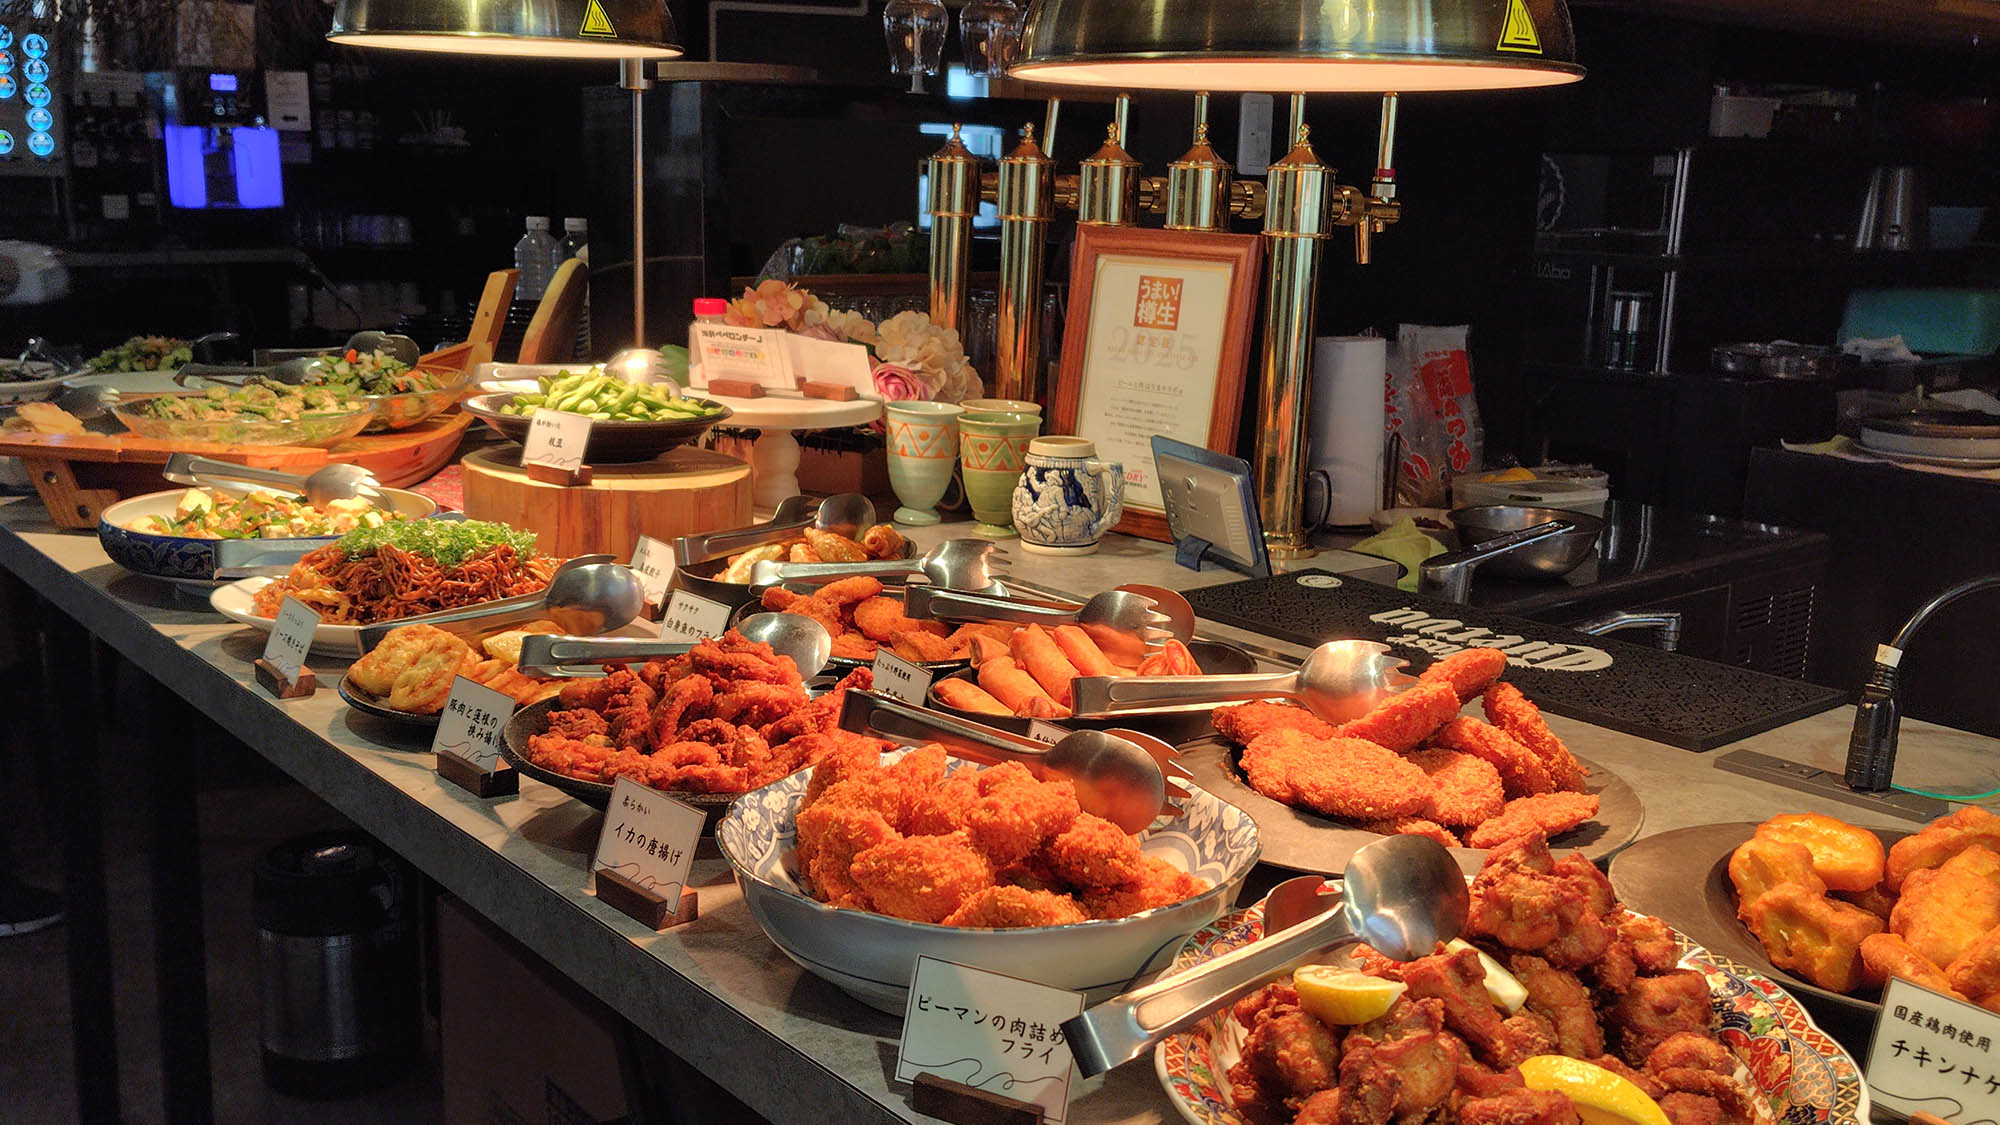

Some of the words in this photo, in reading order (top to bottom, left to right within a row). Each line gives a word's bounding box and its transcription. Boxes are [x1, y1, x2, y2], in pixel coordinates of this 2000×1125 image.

[1140, 279, 1181, 301] うまい!
[1137, 300, 1177, 327] 樽生
[1107, 325, 1198, 370] 2025
[548, 436, 563, 449] 枝豆
[1369, 607, 1614, 672] Cuervo
[449, 698, 498, 729] 豚肉と蓮根の
[622, 795, 651, 815] 柔らかい
[615, 822, 684, 867] イカの唐揚げ
[918, 994, 1066, 1046] ピーマンの肉詰め
[1893, 1005, 1992, 1053] 国産鶏肉使用
[1001, 1039, 1054, 1065] フライ
